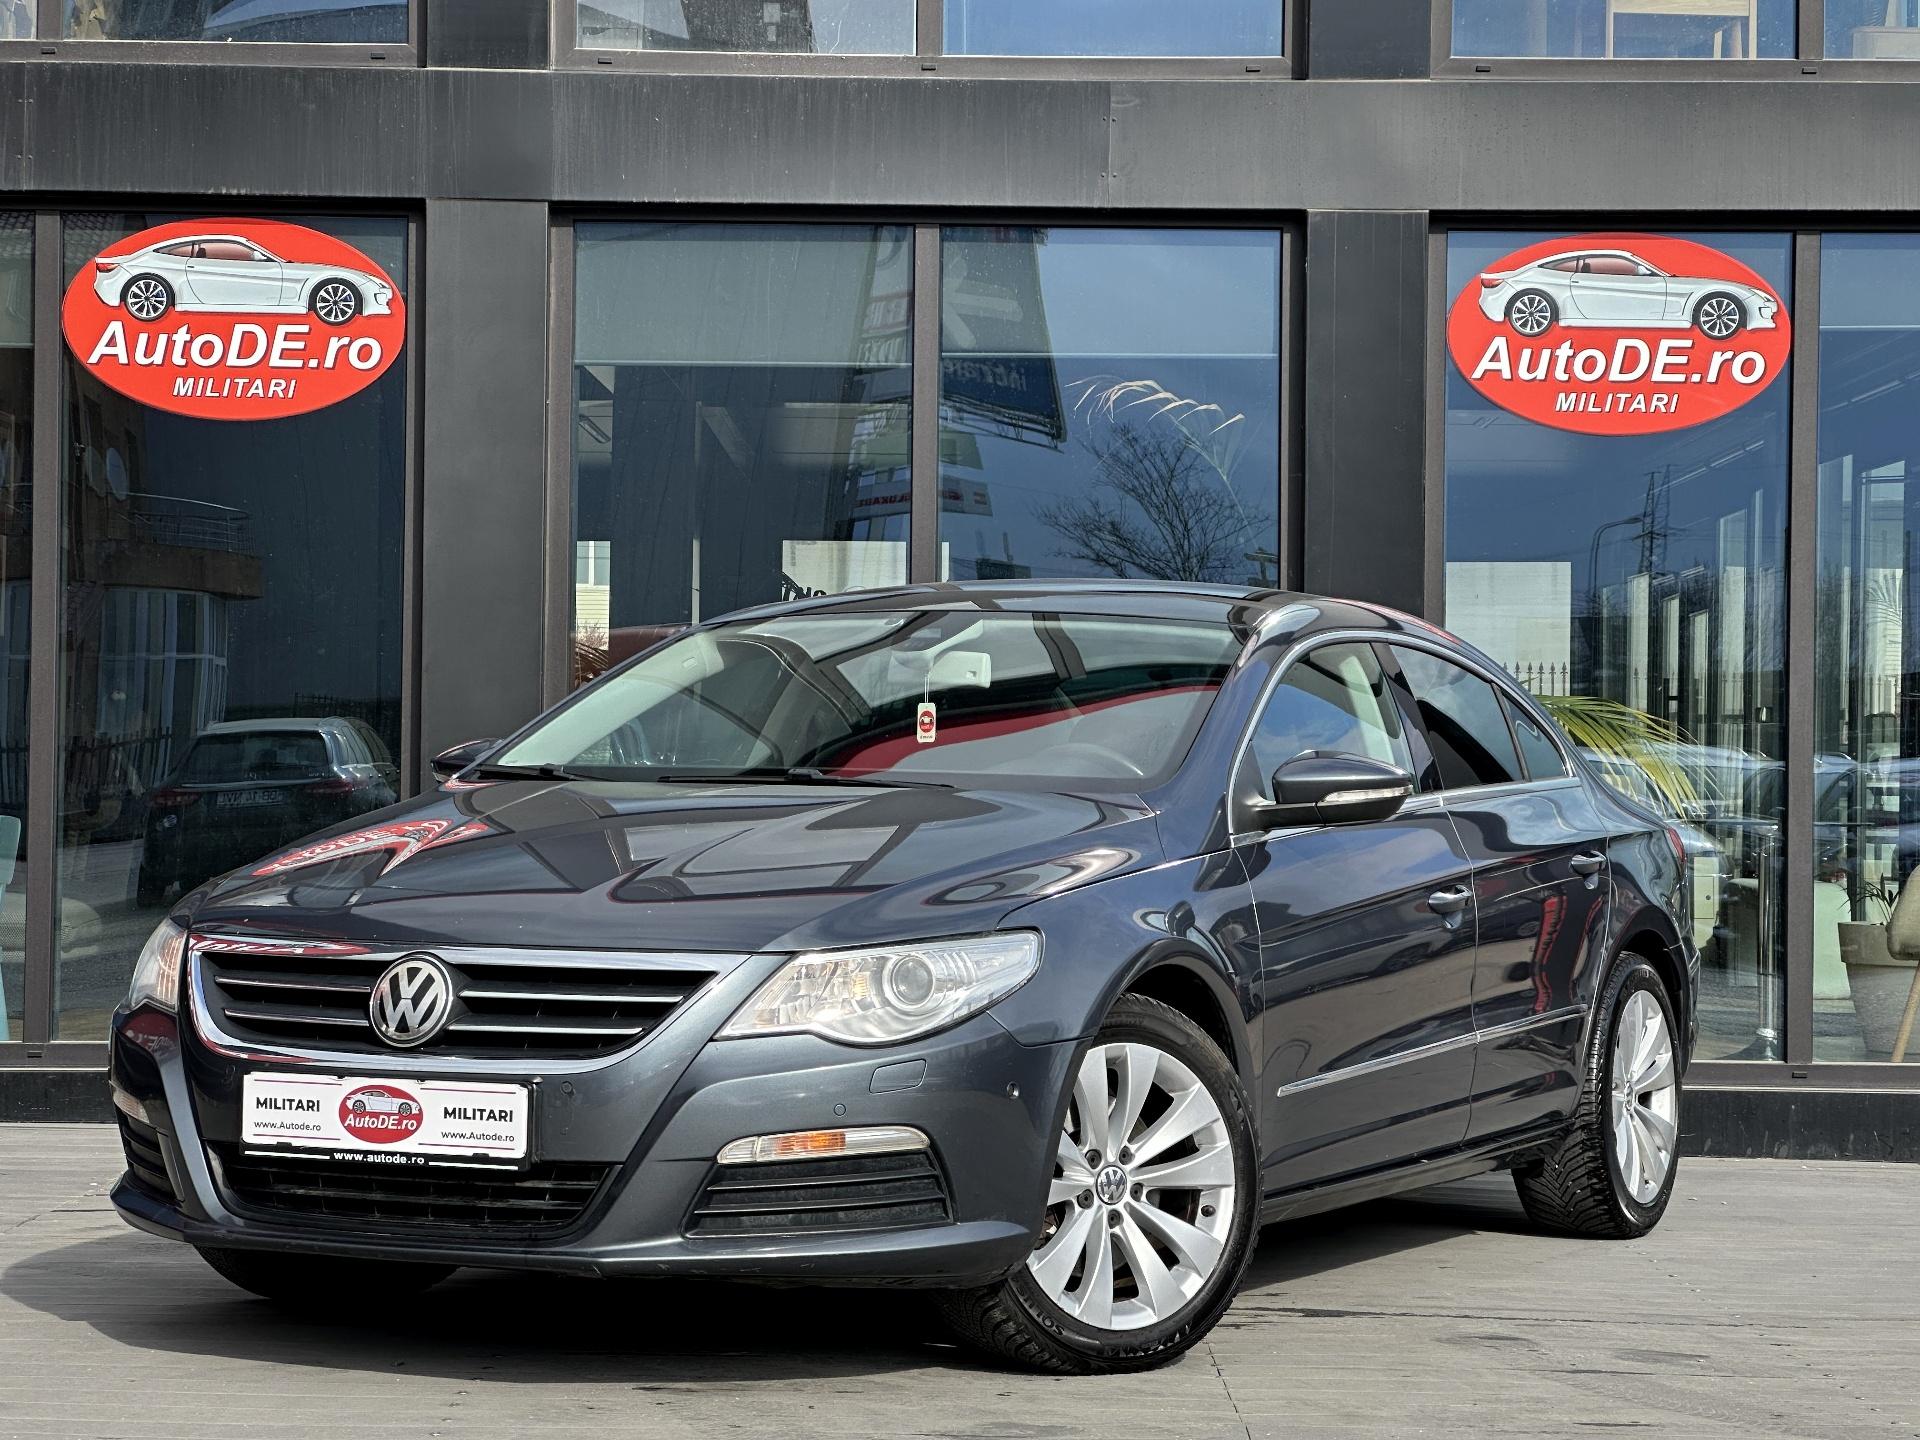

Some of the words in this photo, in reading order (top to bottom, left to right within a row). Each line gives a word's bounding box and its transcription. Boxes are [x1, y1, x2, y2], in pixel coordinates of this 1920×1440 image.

[86, 320, 383, 371] AutoDE.ro
[1471, 336, 1767, 385] AutoDE.ro
[172, 377, 297, 399] MILITARI
[1555, 392, 1679, 414] MILITARI
[255, 1096, 321, 1113] MILITARI
[344, 1112, 418, 1131] AutoDE.ro
[443, 1106, 514, 1123] MILITARI
[253, 1120, 322, 1132] www.Autode.ro
[441, 1130, 516, 1143] www.Autode.ro
[333, 1150, 426, 1165] www.autode.ro
